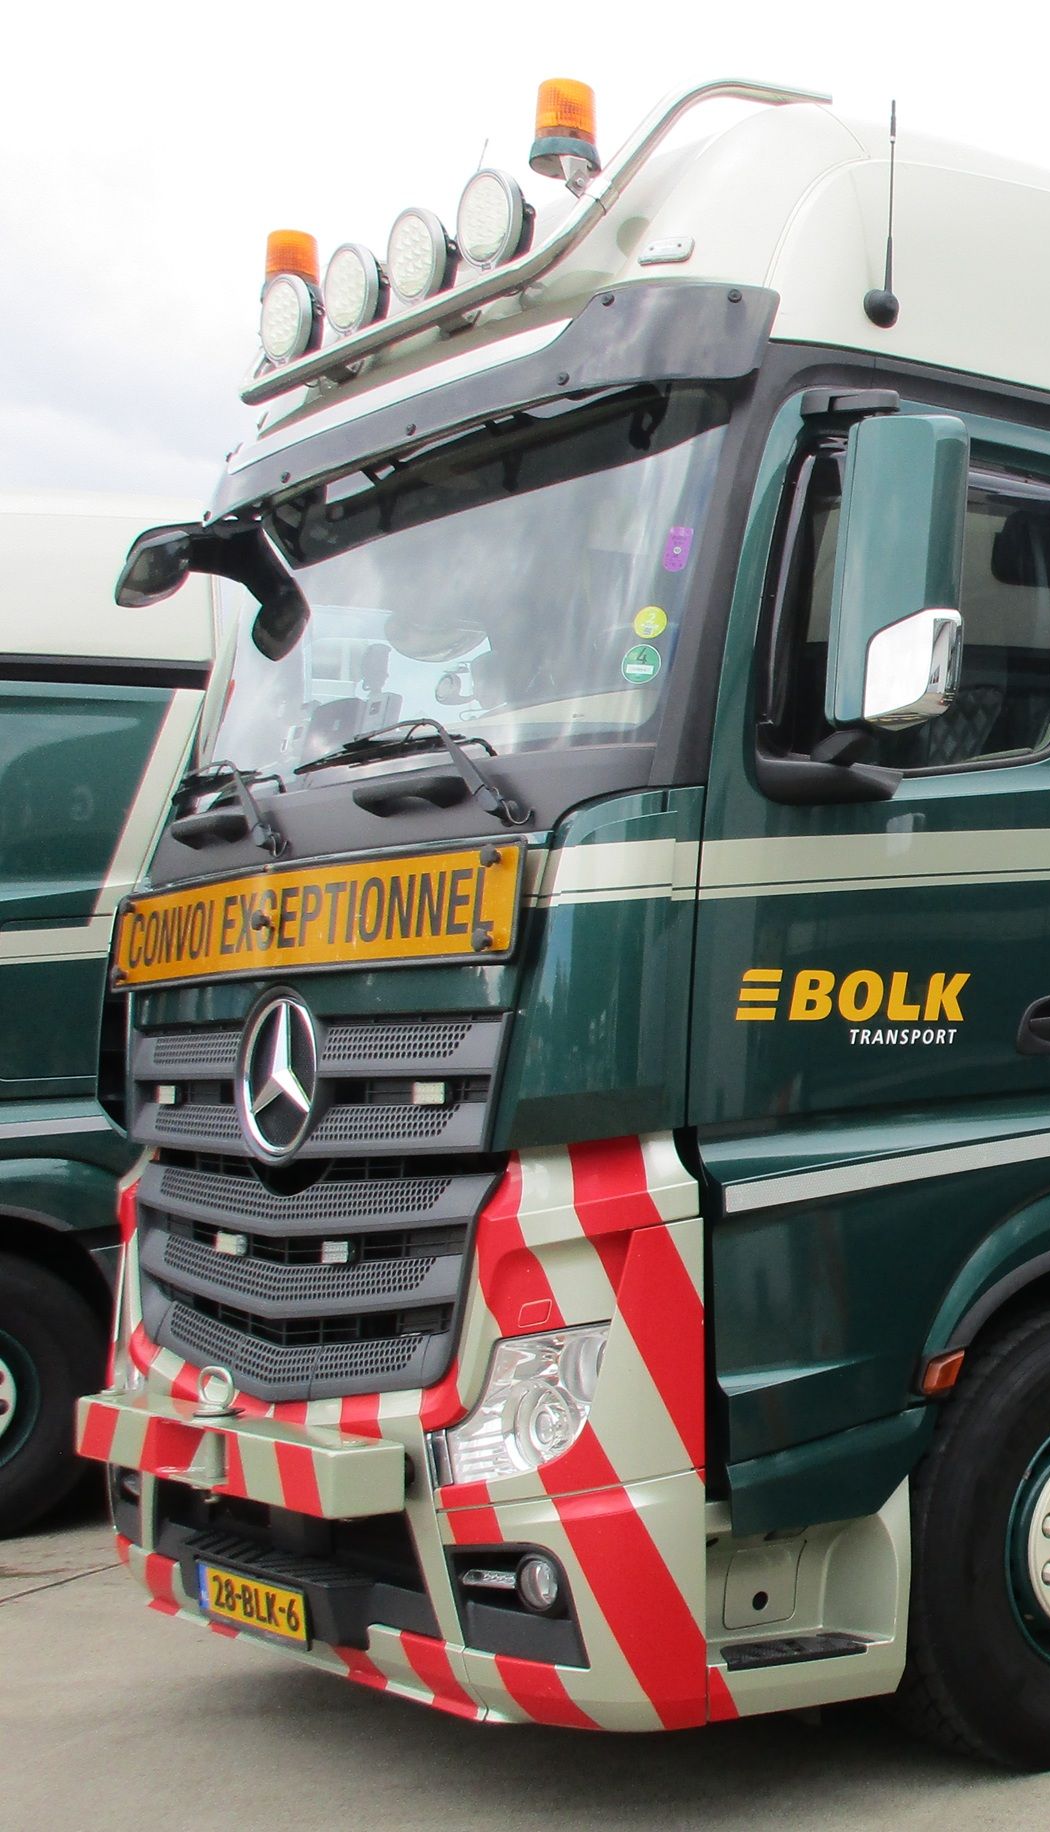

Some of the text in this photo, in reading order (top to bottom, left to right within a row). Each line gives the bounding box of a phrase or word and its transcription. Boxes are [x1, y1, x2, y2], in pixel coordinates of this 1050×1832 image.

[636, 648, 647, 664] 4
[128, 867, 494, 969] CONVOI EXCEPTIONNEL
[788, 969, 972, 1022] BOLK
[849, 1028, 957, 1045] TRANSPORT
[213, 1574, 300, 1632] 28-BLK-6
